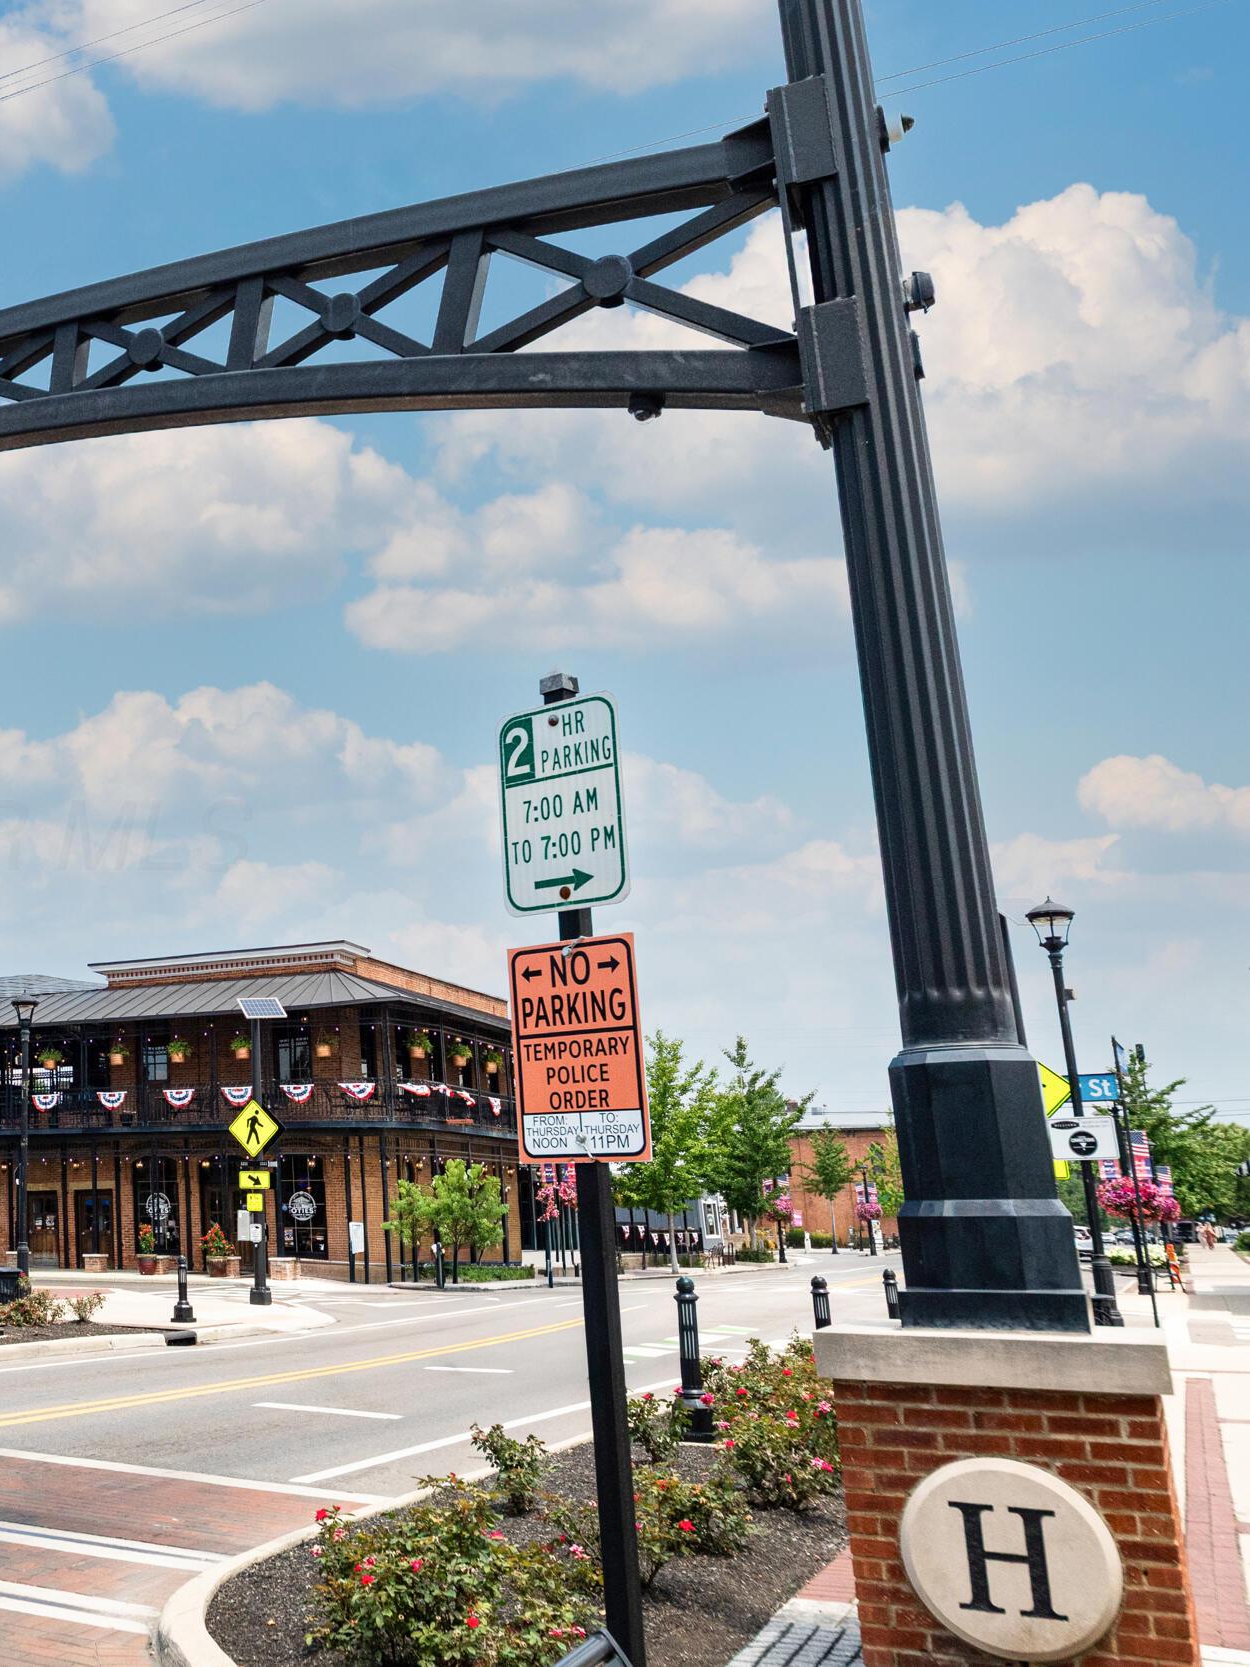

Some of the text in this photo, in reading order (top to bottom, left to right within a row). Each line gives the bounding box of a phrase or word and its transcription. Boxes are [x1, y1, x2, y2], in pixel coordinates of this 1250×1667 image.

[505, 710, 585, 777] 2 HR
[541, 736, 611, 773] PARKING
[523, 787, 598, 824] 7:00 AM
[511, 824, 616, 865] TO 7:00 PM
[549, 950, 591, 988] NO
[521, 987, 626, 1030] PARKING
[524, 1035, 630, 1063] TEMPORARY
[547, 1063, 610, 1086] POLICE
[1088, 1078, 1112, 1098] St
[549, 1089, 610, 1111] ORDER
[533, 1115, 568, 1126] FROM:
[584, 1123, 640, 1136] THURSDAY
[599, 1112, 619, 1124] TO:
[527, 1125, 579, 1137] THURSDAY
[592, 1134, 630, 1149] 11PM
[532, 1137, 568, 1149] NOON
[947, 1500, 1069, 1623] H
